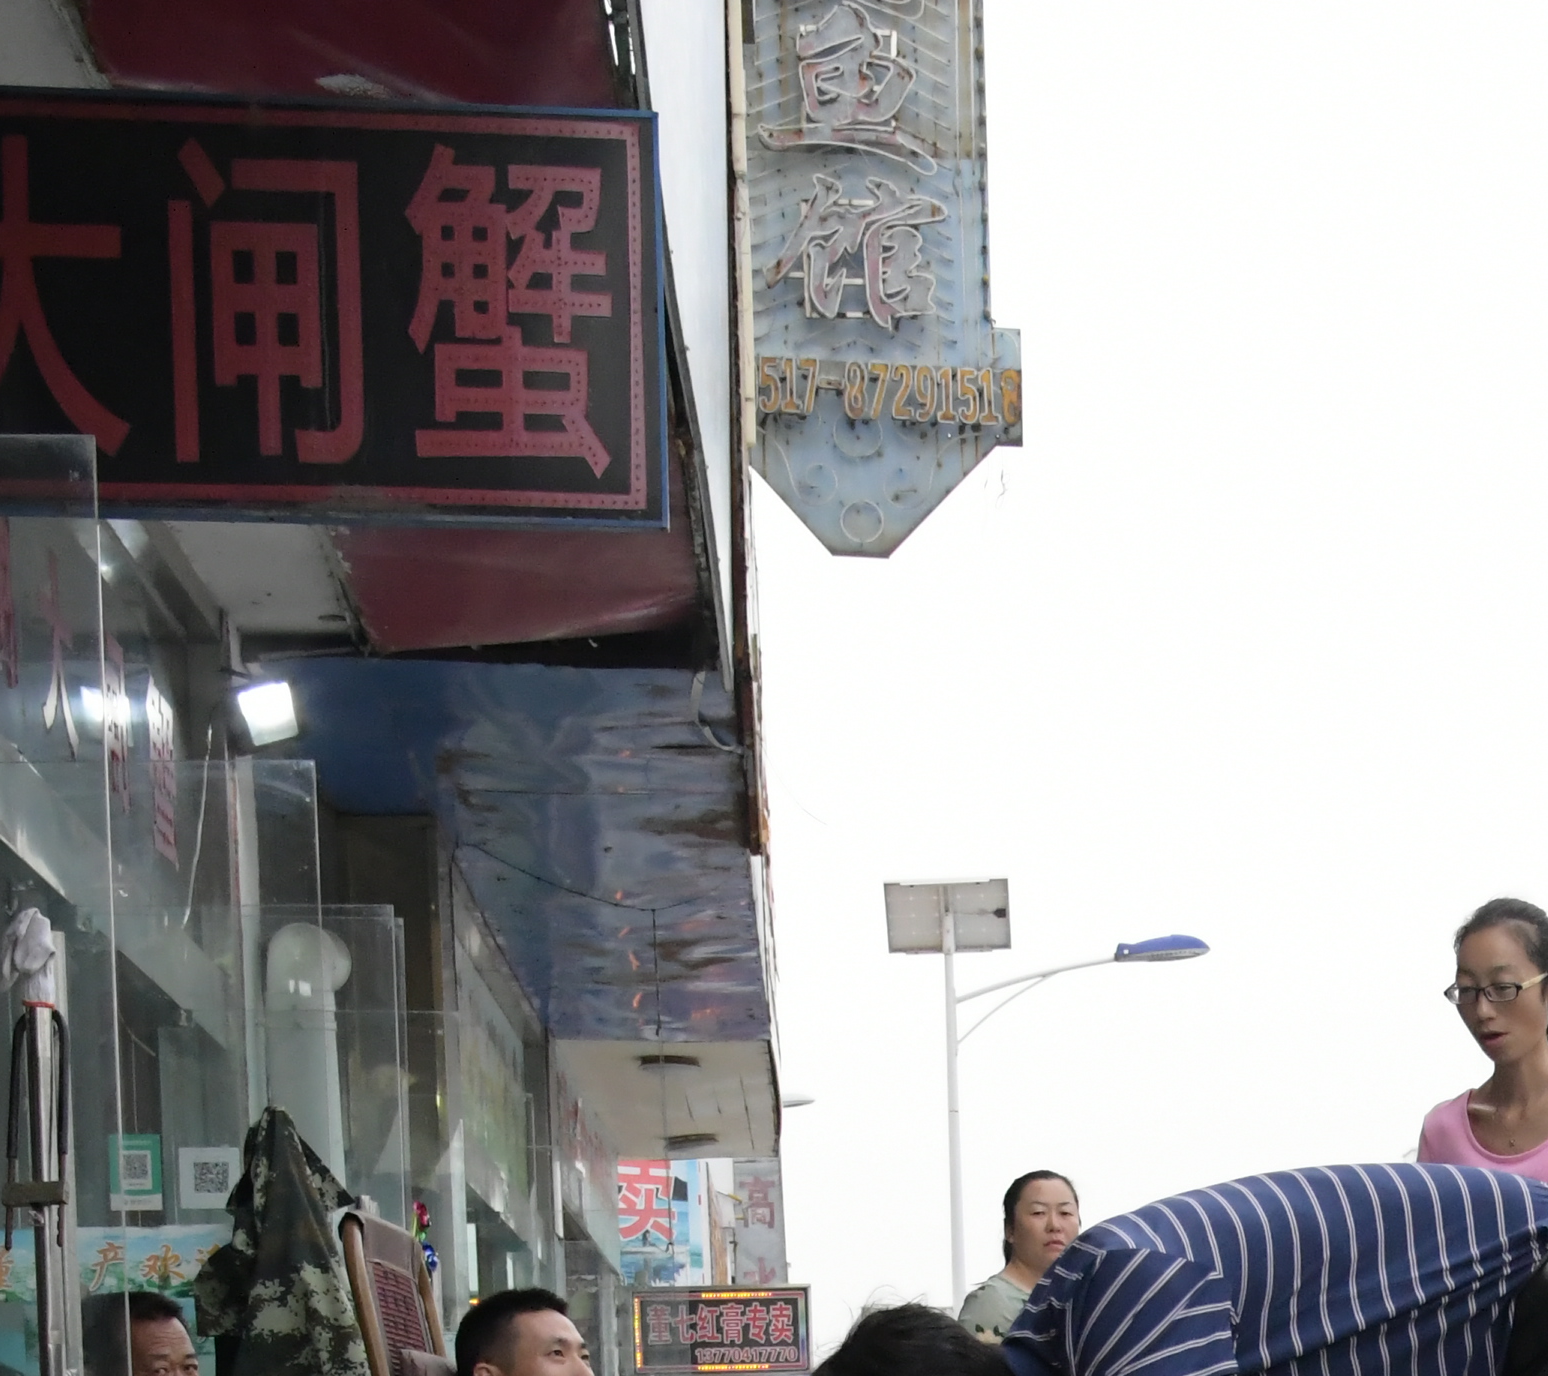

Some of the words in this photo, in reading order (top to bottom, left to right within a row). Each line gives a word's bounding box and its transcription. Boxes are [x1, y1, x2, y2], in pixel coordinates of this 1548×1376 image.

[646, 1301, 795, 1345] 董七红膏专卖
[694, 1345, 799, 1364] 13770417770
